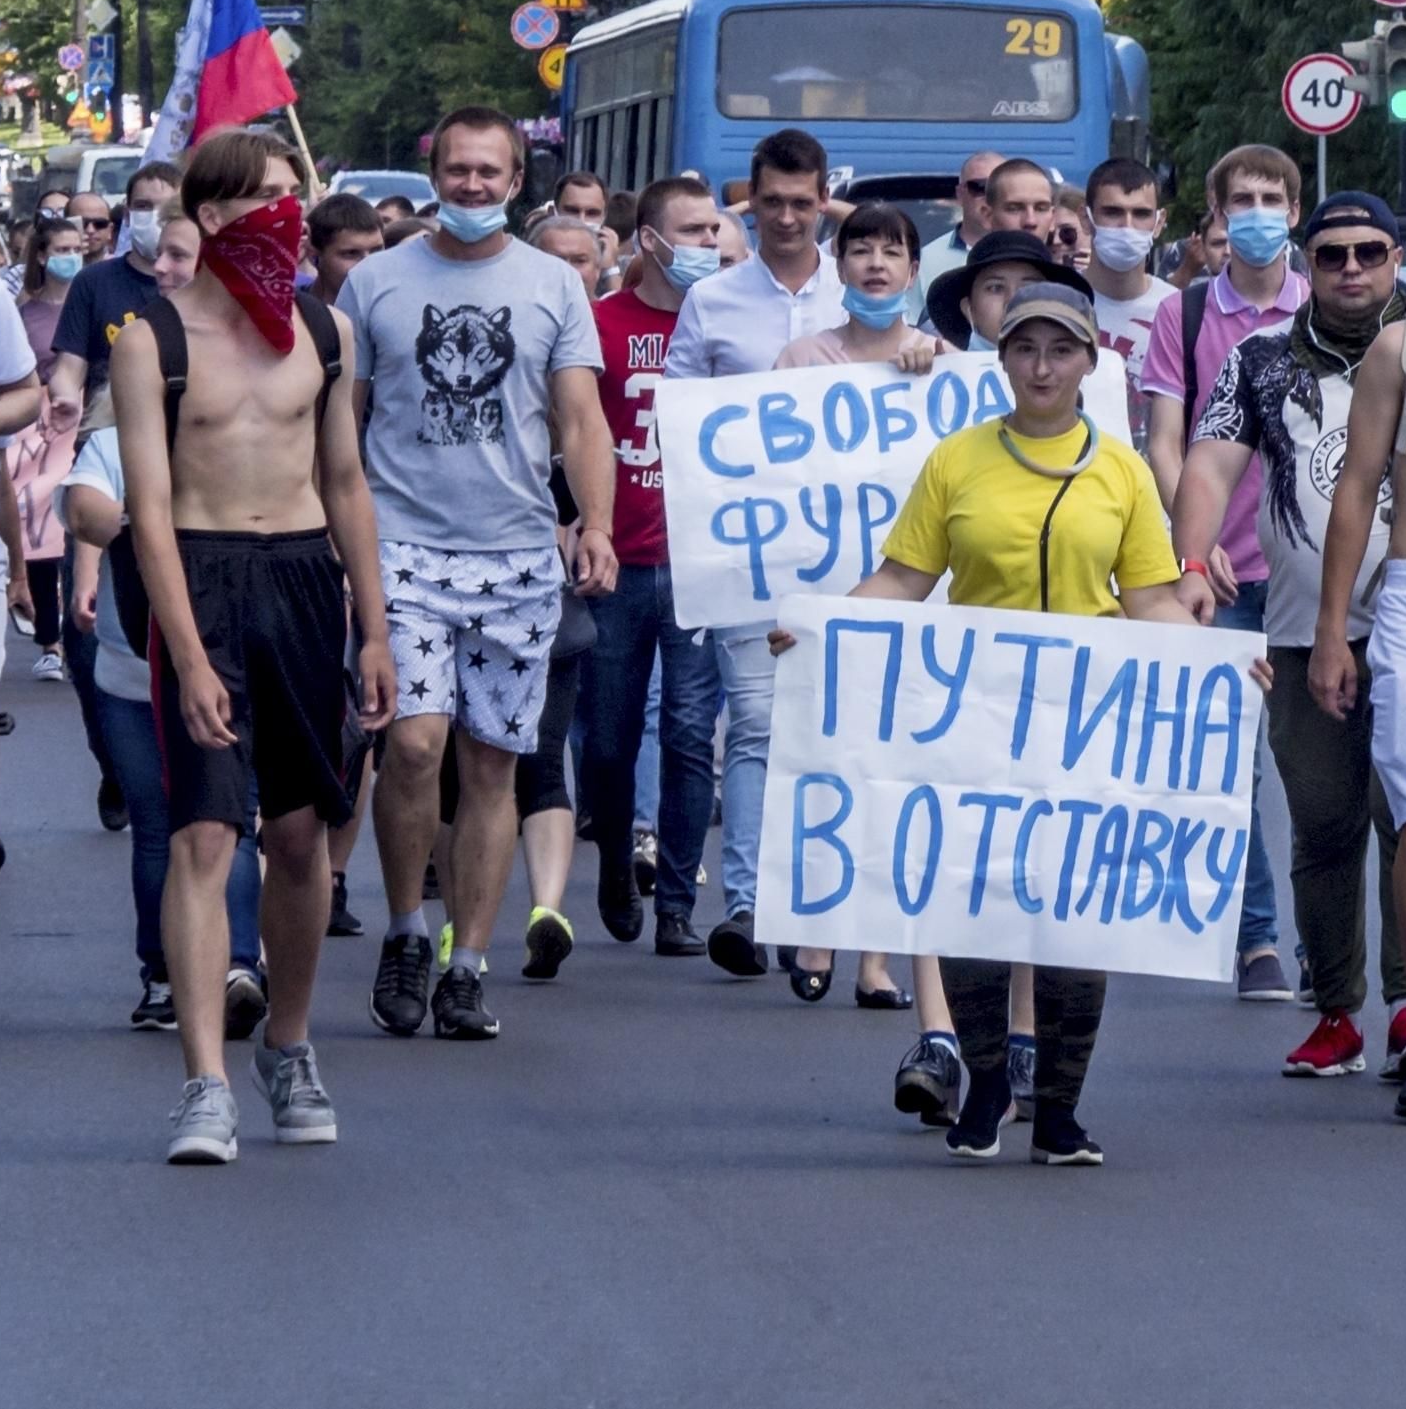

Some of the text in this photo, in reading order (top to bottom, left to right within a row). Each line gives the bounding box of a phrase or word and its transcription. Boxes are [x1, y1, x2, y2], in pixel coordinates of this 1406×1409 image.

[1004, 18, 1062, 57] 29
[991, 100, 1050, 117] ABS
[1301, 78, 1343, 108] 40
[627, 332, 674, 369] MI
[821, 617, 1243, 793] ПУТИНА
[791, 772, 1247, 934] В ОТСТАВКУ
